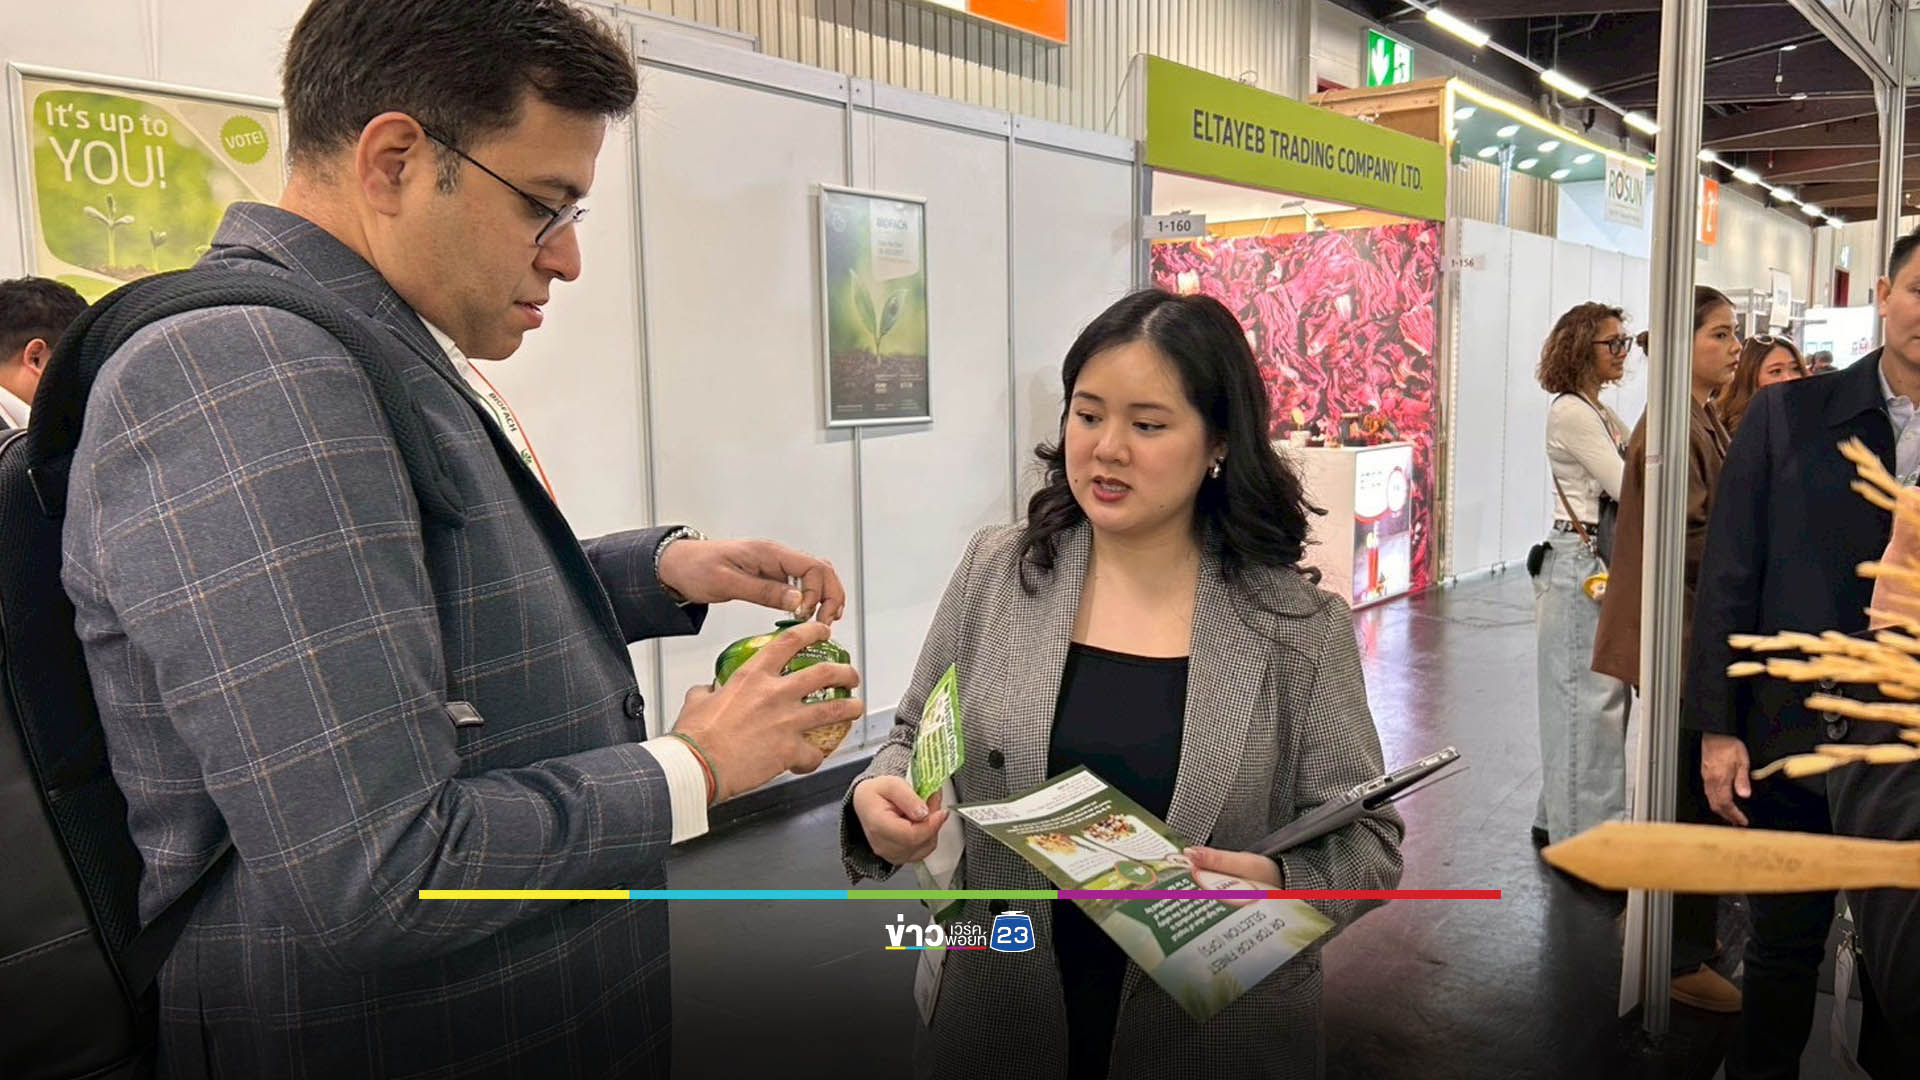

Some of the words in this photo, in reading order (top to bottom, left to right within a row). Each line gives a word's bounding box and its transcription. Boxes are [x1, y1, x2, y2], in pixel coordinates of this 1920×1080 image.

[45, 102, 90, 129] It's
[100, 112, 134, 138] up
[140, 114, 168, 137] to
[225, 130, 265, 149] VOTE!
[1193, 109, 1265, 153] ELTAYEB
[1269, 129, 1334, 170] TRADING
[1337, 147, 1398, 184] COMPANY
[1401, 163, 1423, 191] LTD.
[49, 136, 167, 190] YOU!
[1157, 219, 1191, 232] 1-160
[489, 392, 517, 432] BIOFACH
